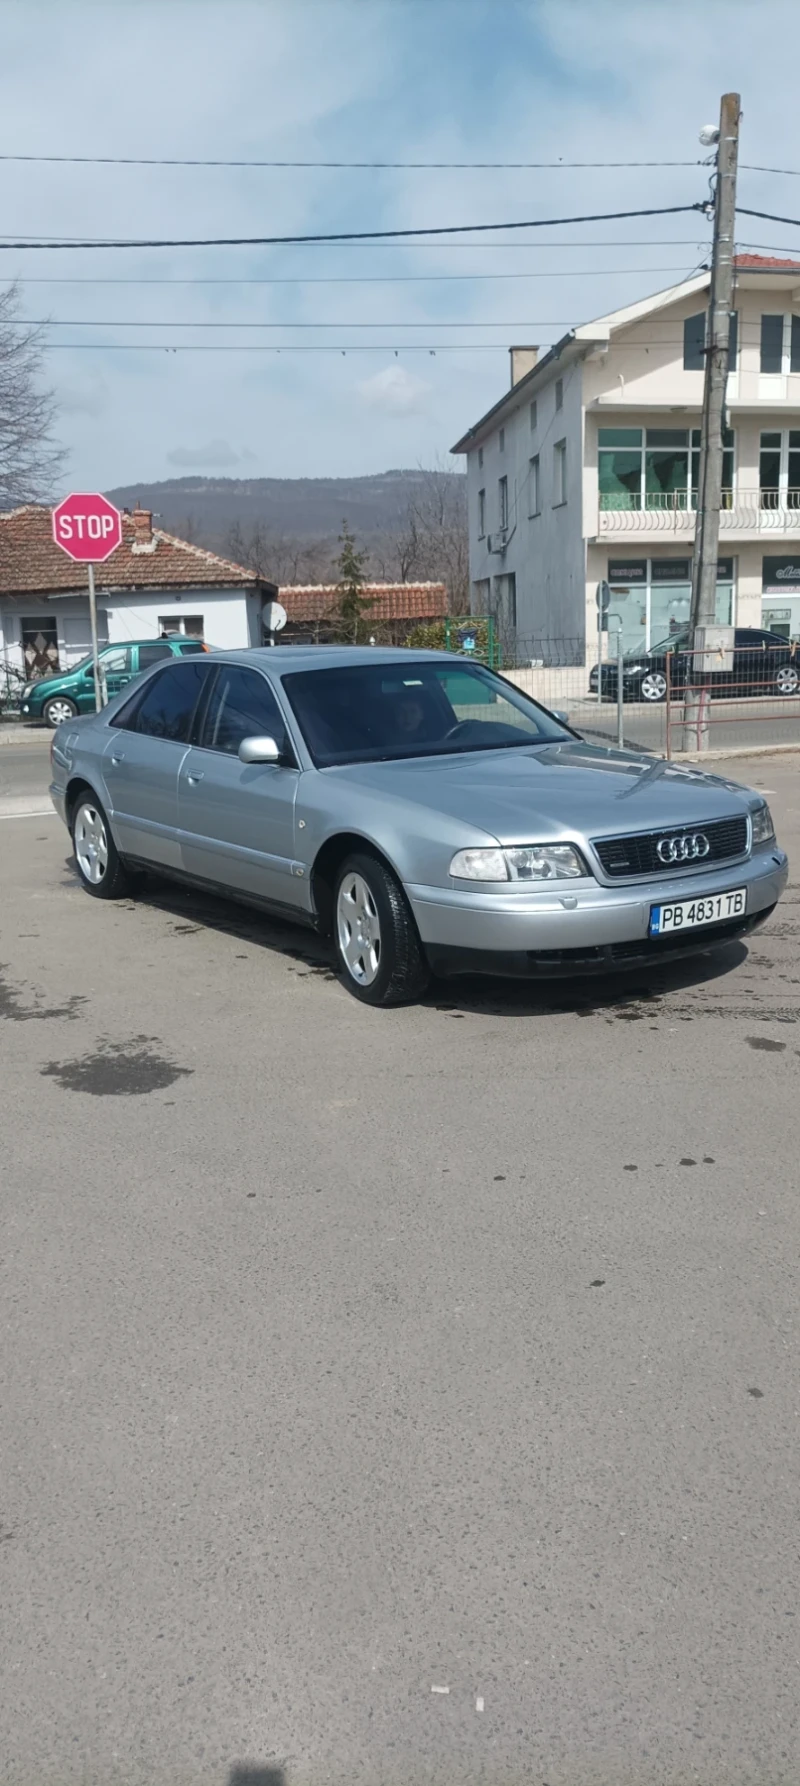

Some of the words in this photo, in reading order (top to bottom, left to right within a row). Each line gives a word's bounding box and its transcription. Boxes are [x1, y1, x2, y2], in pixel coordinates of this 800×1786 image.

[59, 515, 114, 539] STOP
[662, 906, 683, 929] PB
[687, 898, 722, 923] 4831
[726, 893, 743, 915] TB
